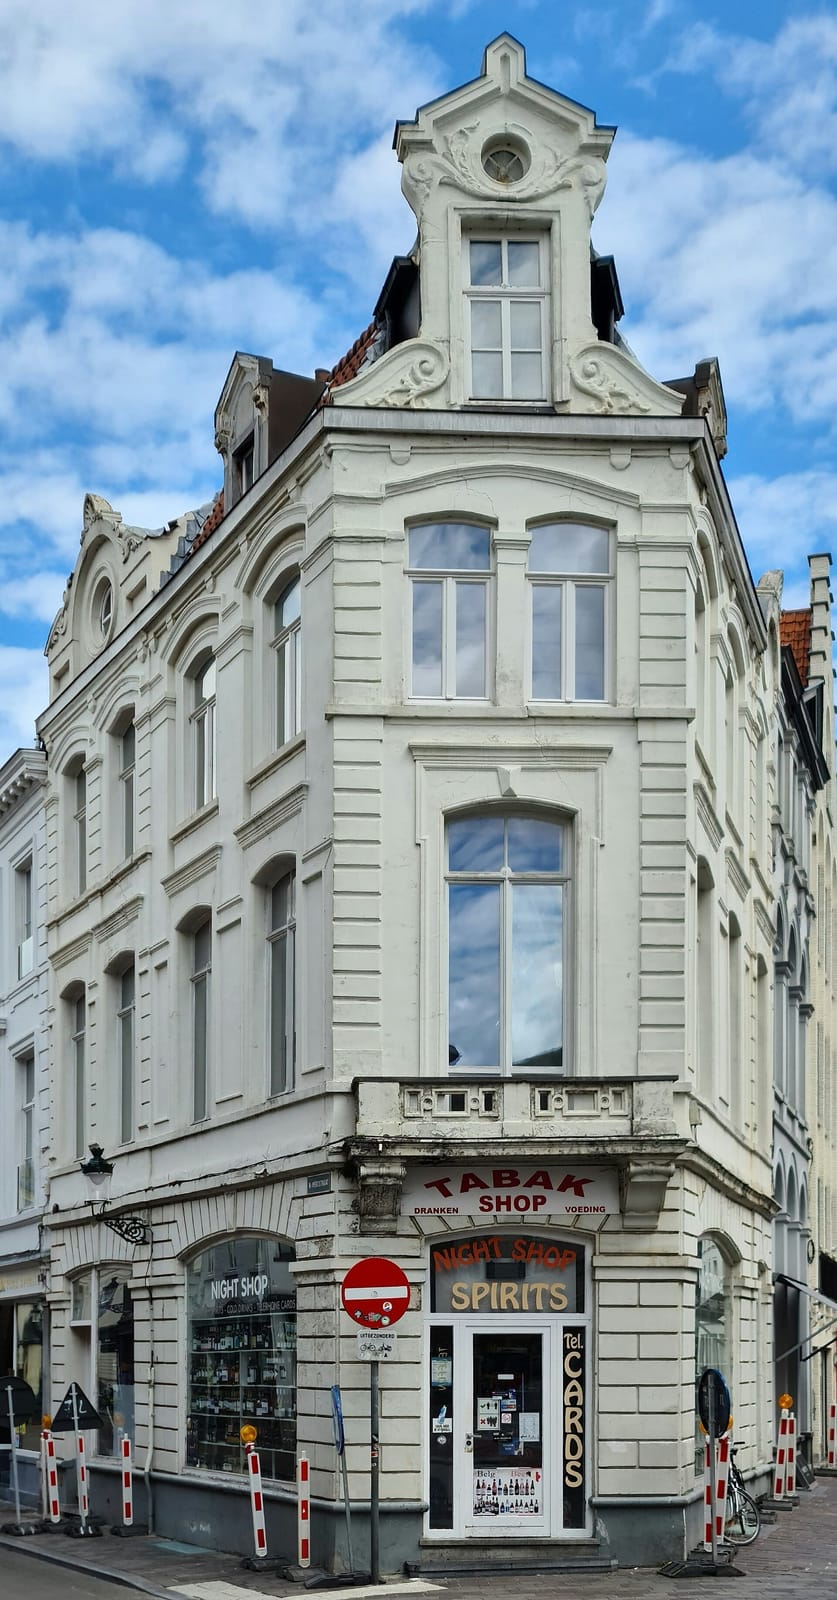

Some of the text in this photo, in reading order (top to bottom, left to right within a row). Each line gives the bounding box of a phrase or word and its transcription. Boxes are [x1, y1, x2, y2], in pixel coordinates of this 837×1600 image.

[424, 1169, 595, 1199] TABAK
[478, 1195, 547, 1213] SHOP
[432, 1236, 577, 1273] NIGHT SHOP
[211, 1274, 268, 1300] NIGHT SHOP
[451, 1282, 568, 1311] SPIRITS
[564, 1333, 584, 1349] Tel.
[564, 1351, 583, 1488] CARDS
